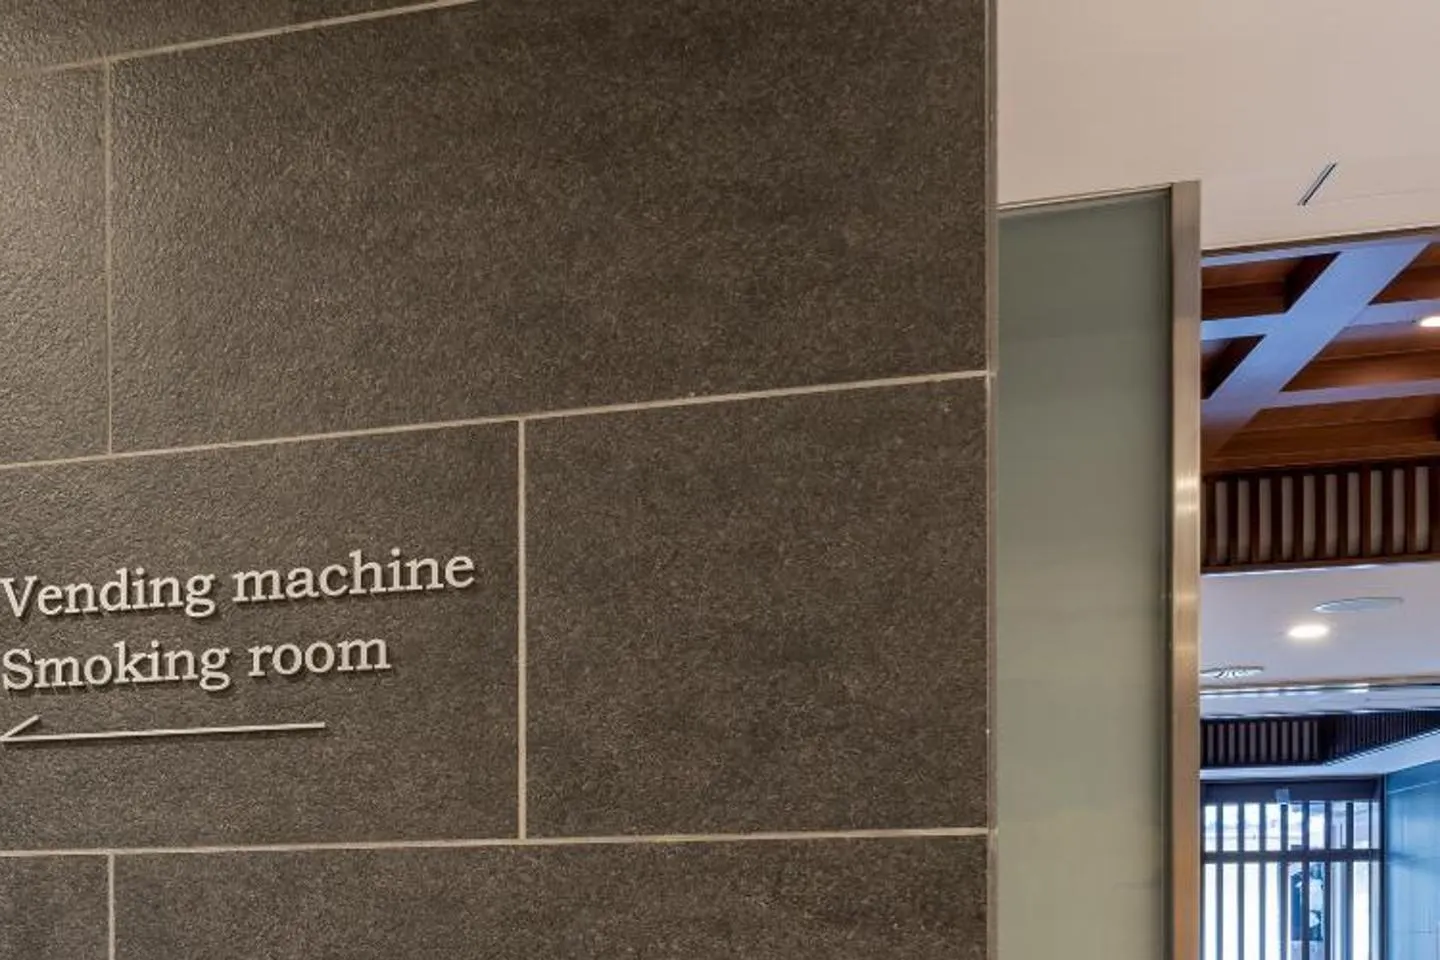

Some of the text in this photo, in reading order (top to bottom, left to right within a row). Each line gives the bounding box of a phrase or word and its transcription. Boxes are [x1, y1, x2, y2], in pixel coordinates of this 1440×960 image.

[0, 547, 476, 618] Vending machine
[2, 636, 392, 692] Smoking room
